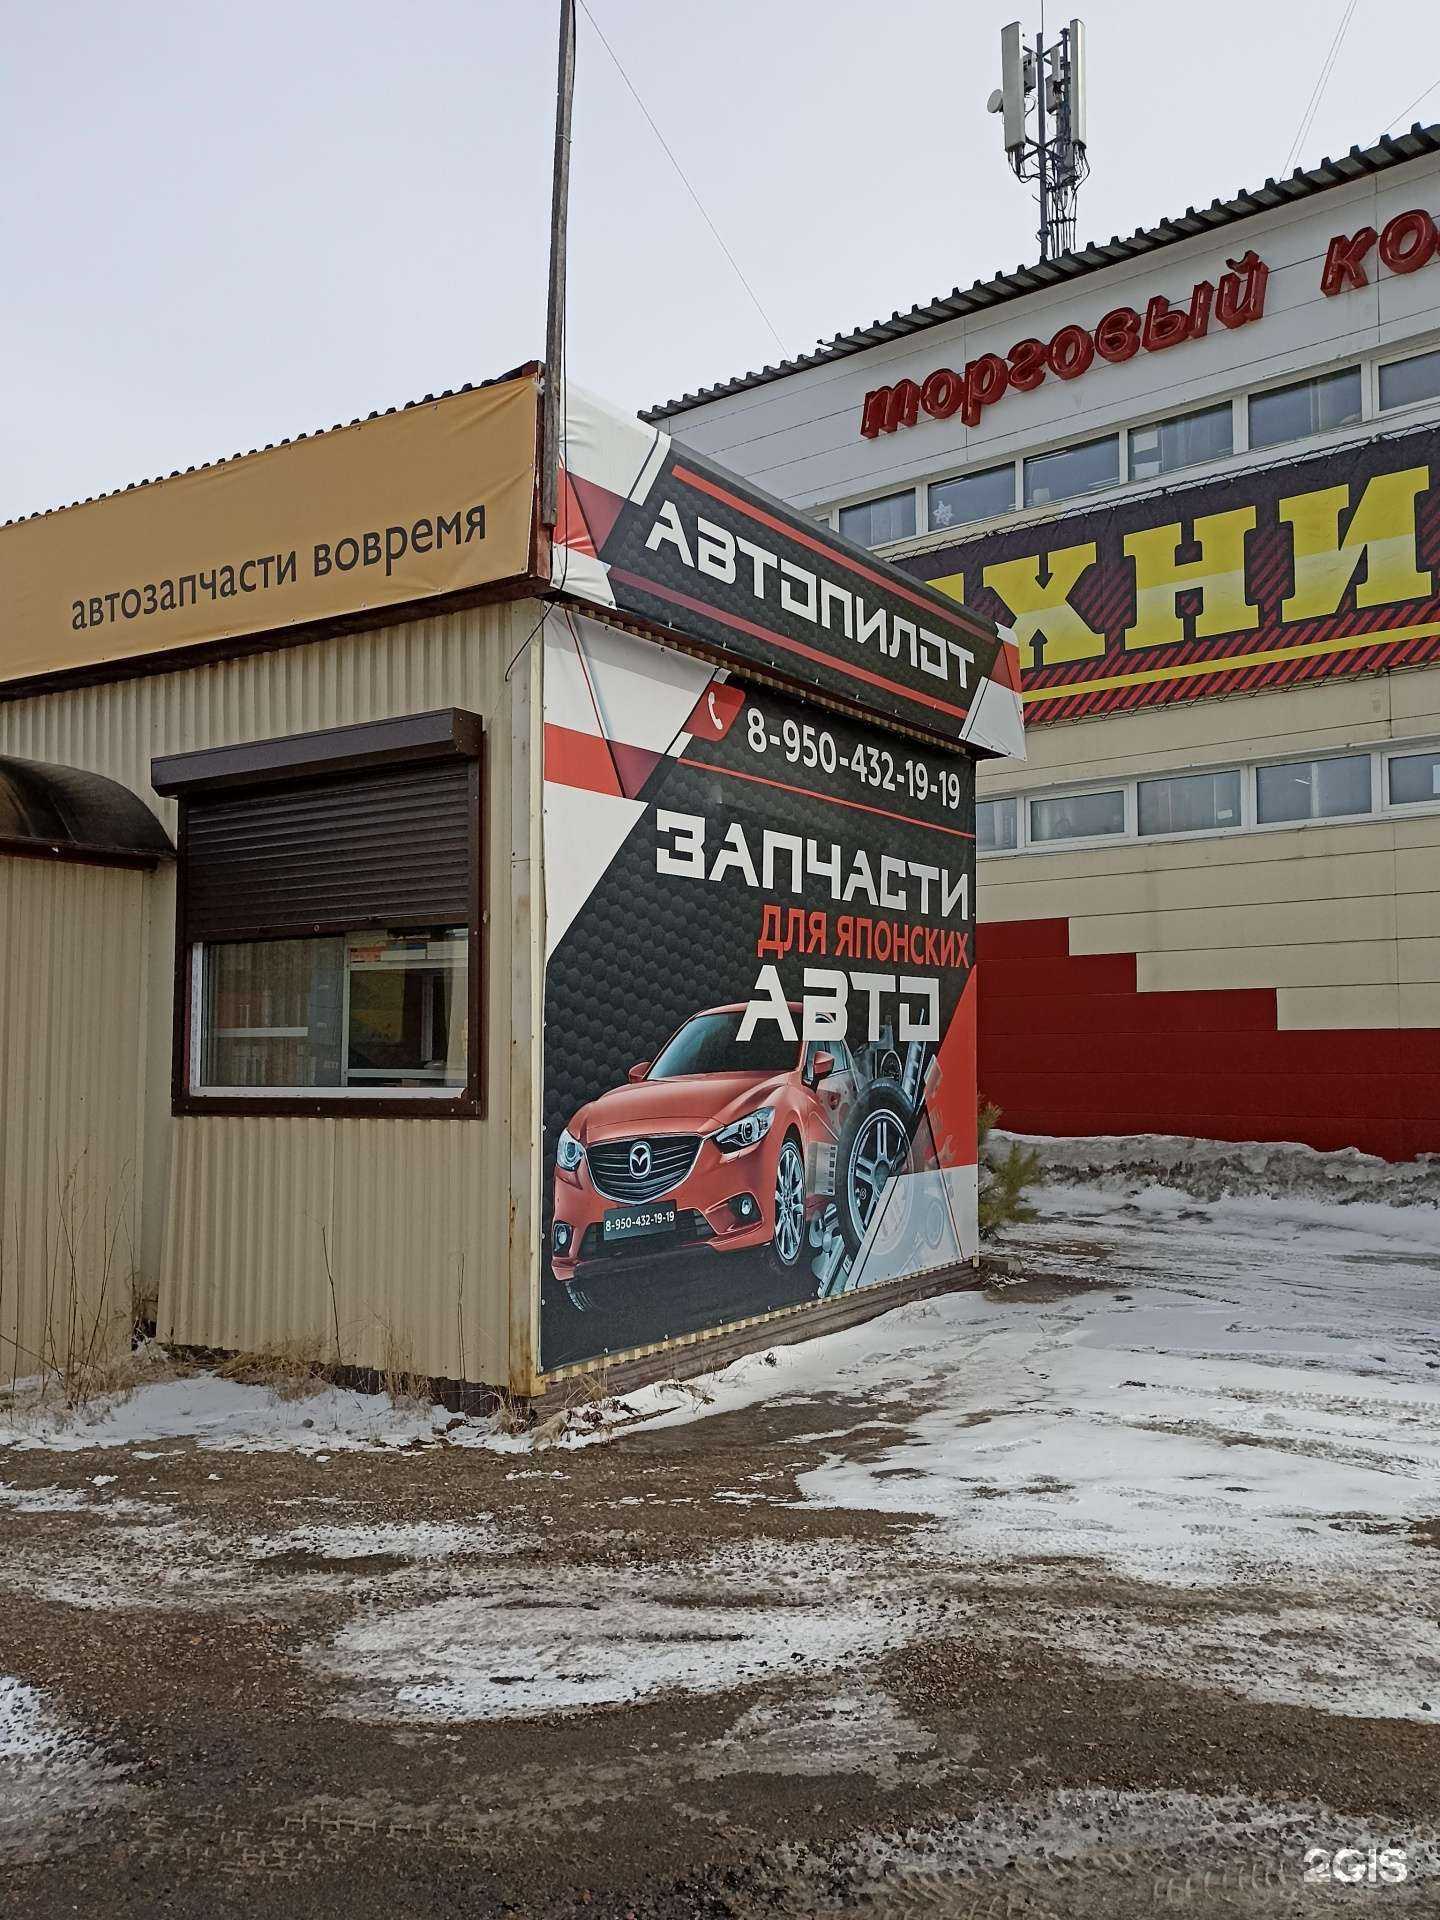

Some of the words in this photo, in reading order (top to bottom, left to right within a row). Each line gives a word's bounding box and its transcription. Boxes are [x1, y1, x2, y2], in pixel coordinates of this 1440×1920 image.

[860, 250, 1270, 438] торговый
[1320, 208, 1440, 298] ко
[70, 550, 297, 630] автозапчасти
[313, 504, 487, 576] вовремя
[644, 499, 975, 689] АВТОПИЛОТ
[926, 465, 1431, 669] ХНИ
[746, 707, 961, 811] 8-950-432-19-19
[656, 808, 970, 921] ЗАПЧАСТИ
[756, 904, 827, 960] ДЛЯ
[834, 916, 970, 969] ЯПОНСКИХ
[735, 963, 940, 1042] АВТО
[605, 1211, 675, 1232] 8-950-432-19-19
